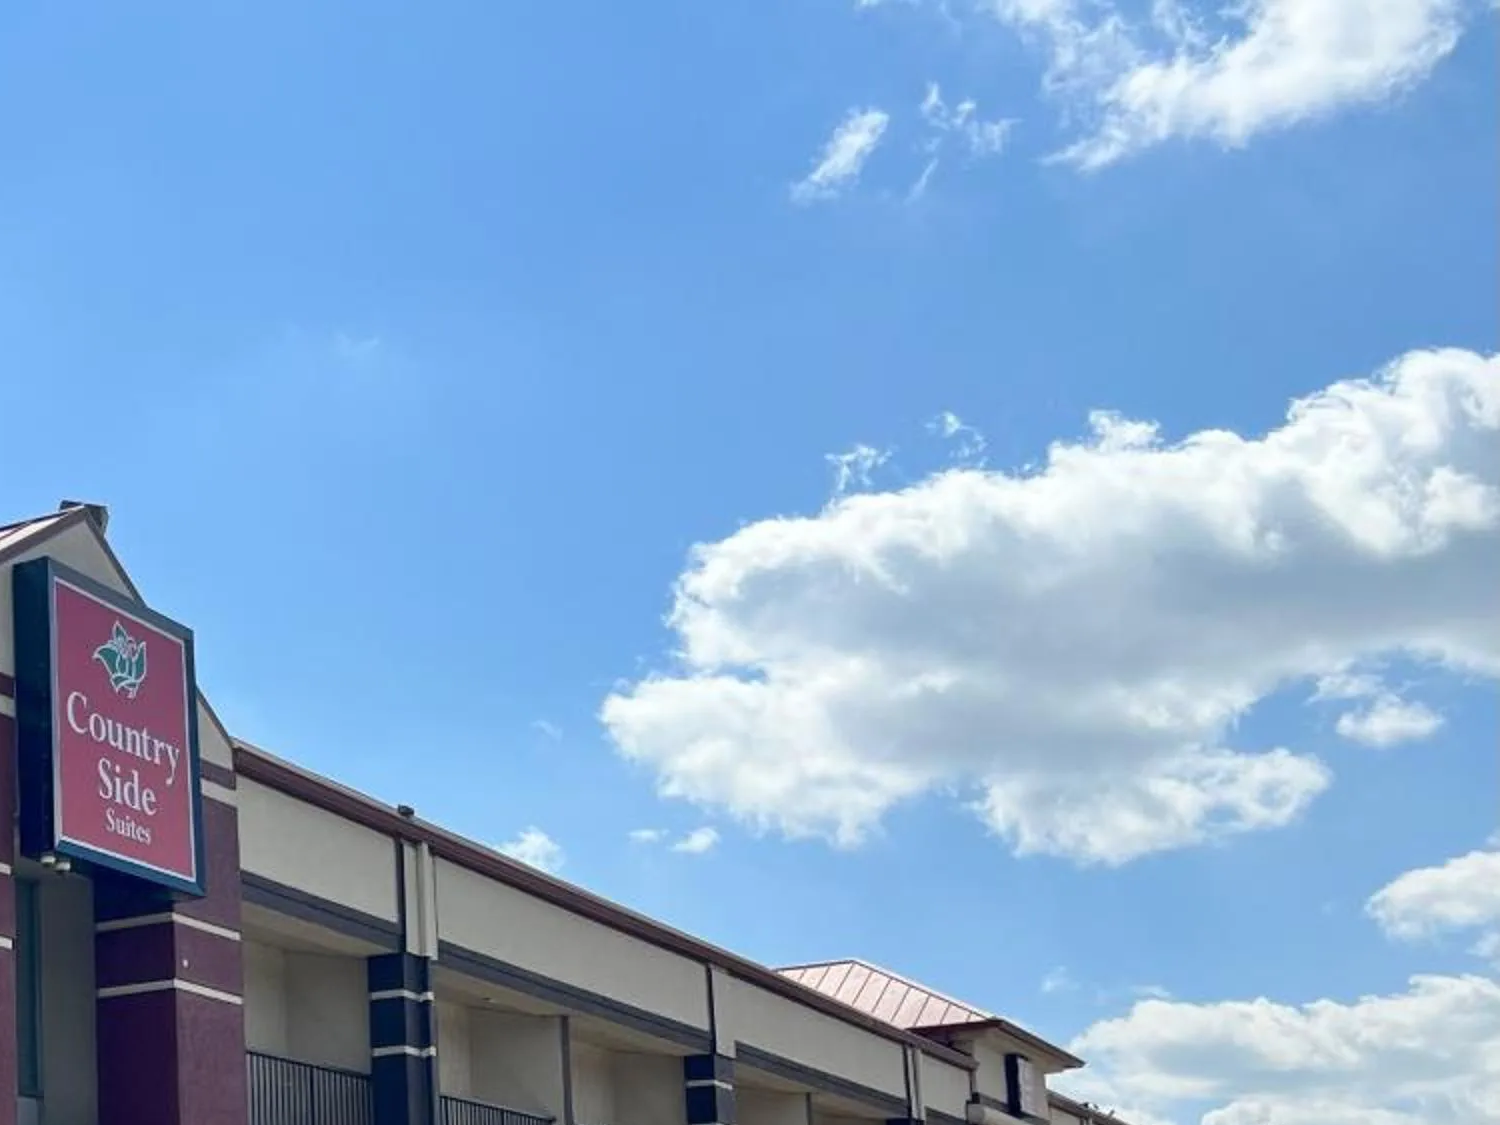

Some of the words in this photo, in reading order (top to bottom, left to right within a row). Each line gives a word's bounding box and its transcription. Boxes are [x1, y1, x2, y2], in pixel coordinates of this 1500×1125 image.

[66, 691, 180, 785] Country
[98, 756, 157, 816] Side
[105, 809, 151, 845] Suites
